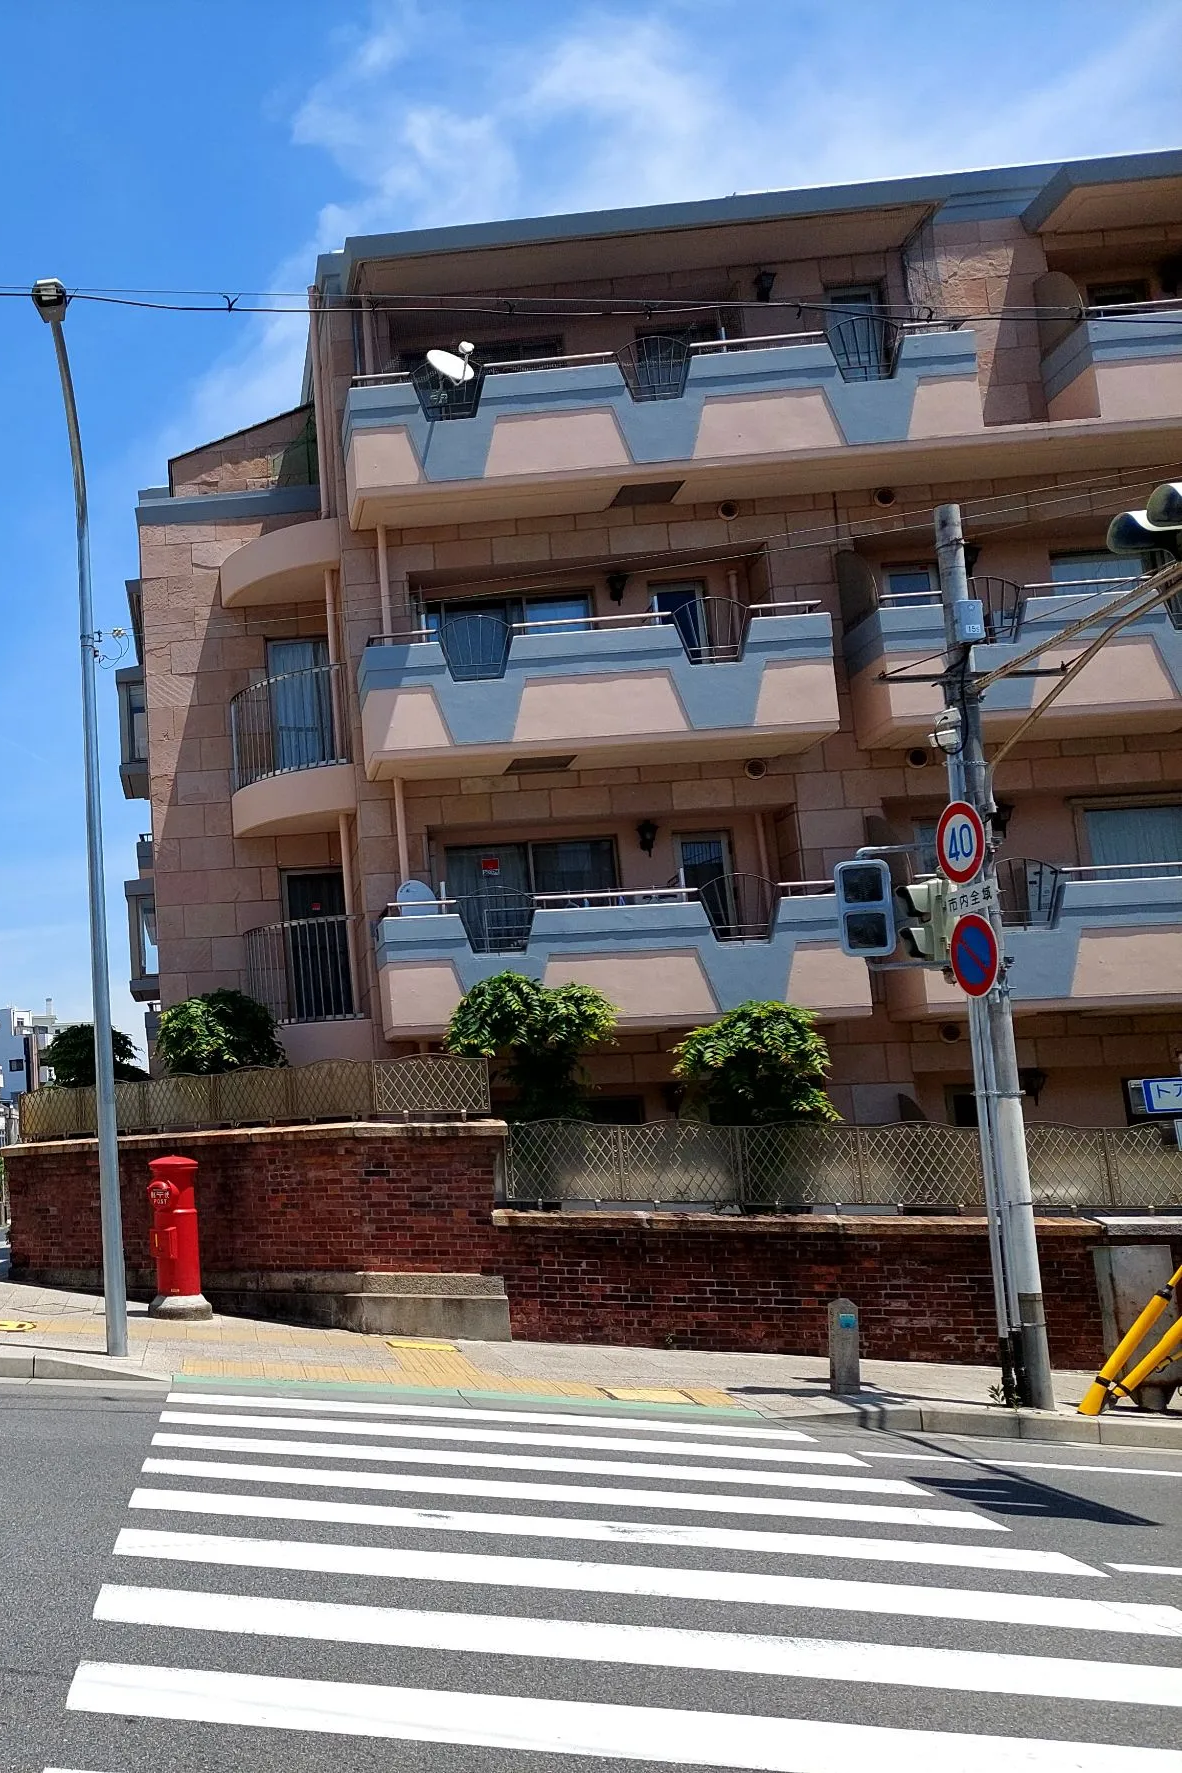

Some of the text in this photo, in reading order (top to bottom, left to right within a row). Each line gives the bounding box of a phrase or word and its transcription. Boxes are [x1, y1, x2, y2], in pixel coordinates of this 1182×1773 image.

[949, 823, 974, 862] 40
[947, 885, 993, 914] 市内全域
